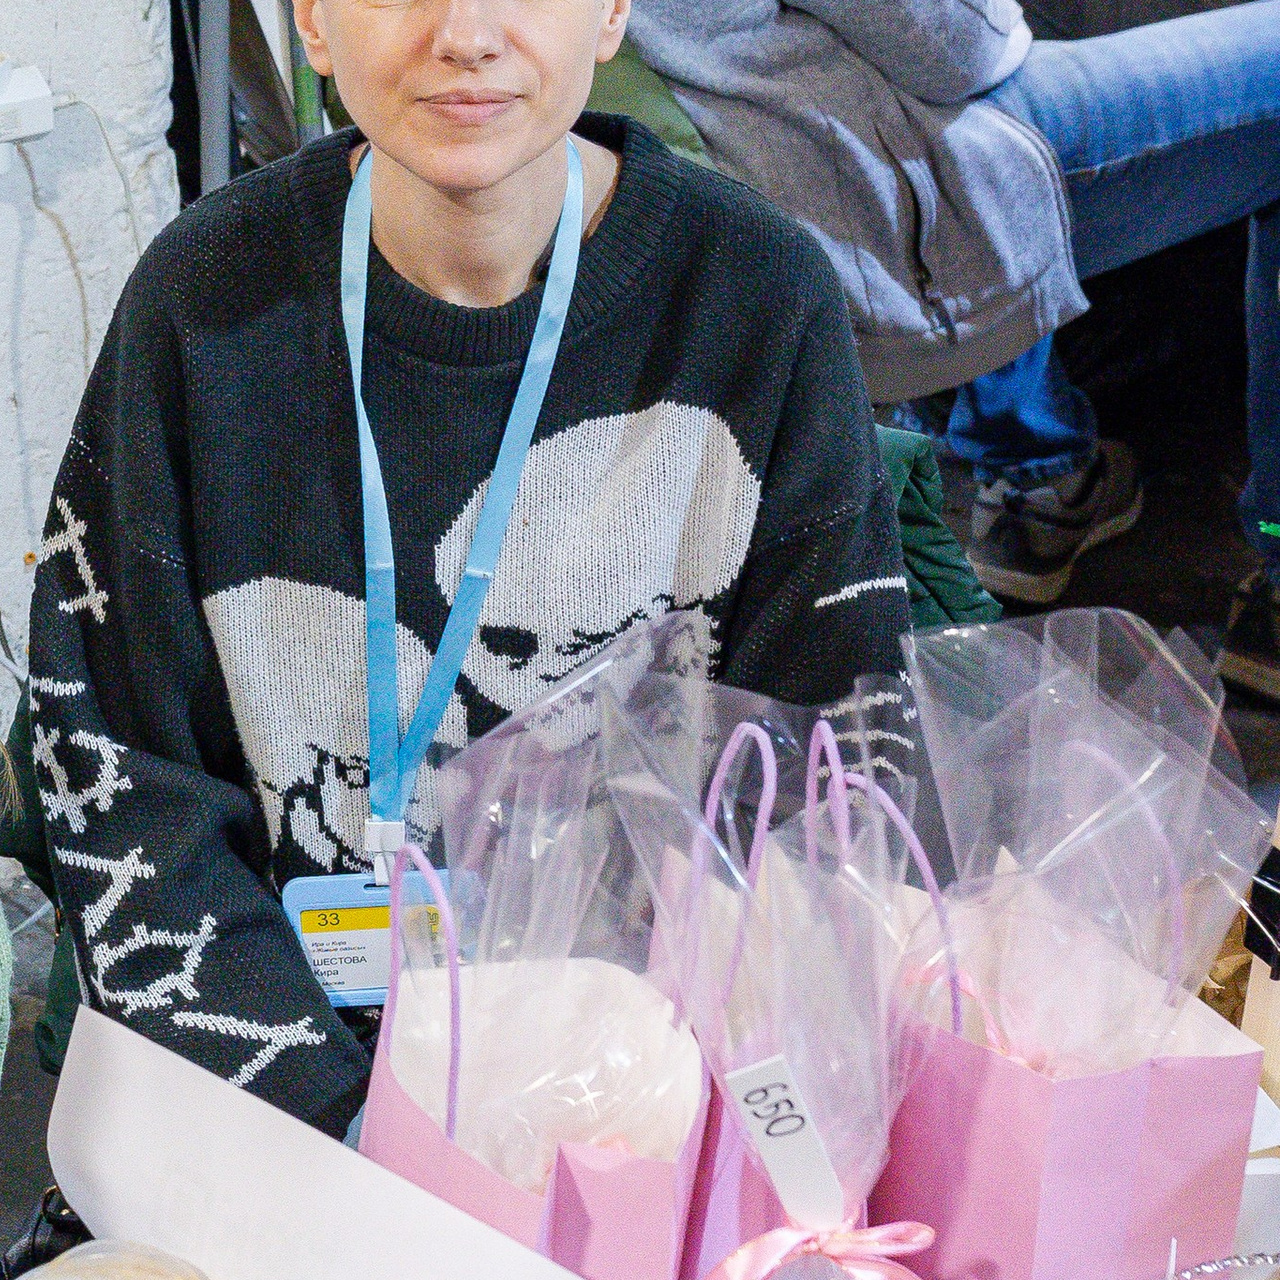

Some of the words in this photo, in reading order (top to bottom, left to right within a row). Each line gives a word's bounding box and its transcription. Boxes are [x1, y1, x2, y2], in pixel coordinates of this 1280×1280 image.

[318, 913, 340, 927] 33
[313, 956, 367, 966] ШЕСТОВА
[314, 969, 339, 977] Кира
[743, 1082, 805, 1136] 650
